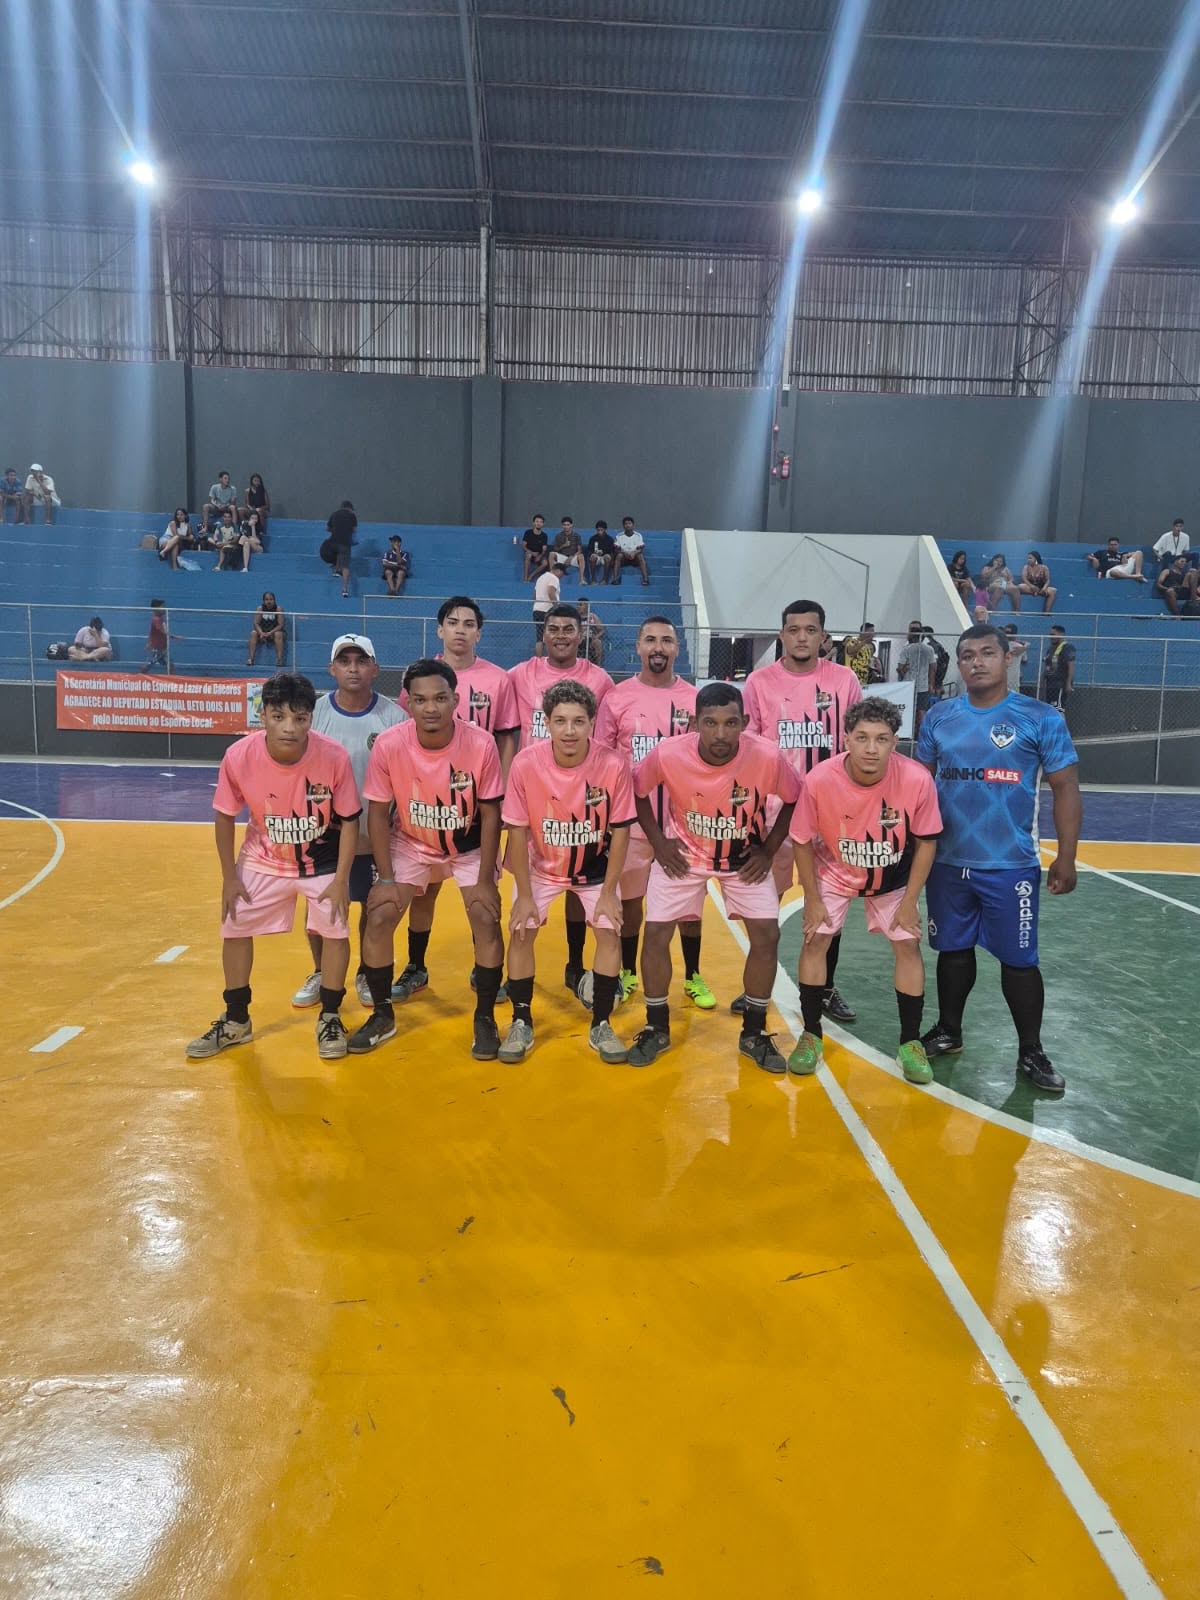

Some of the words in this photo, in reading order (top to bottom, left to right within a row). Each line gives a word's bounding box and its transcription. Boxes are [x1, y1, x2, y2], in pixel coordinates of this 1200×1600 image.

[106, 679, 142, 691] Municipal
[142, 680, 152, 691] de
[152, 681, 178, 693] Esporte
[183, 682, 202, 694] Lazer
[64, 695, 102, 707] AGRADECE
[102, 696, 112, 708] AO
[113, 697, 150, 709] DEPUTADO
[150, 698, 186, 711] ESTADUAL
[206, 700, 223, 712] DOIS
[224, 701, 230, 712] A
[230, 701, 242, 713] UM
[93, 713, 111, 725] pelo
[149, 716, 159, 726] ao
[160, 715, 190, 728] Esporte
[778, 721, 823, 736] CARLOS
[779, 734, 833, 749] AVALLONE
[987, 770, 1019, 781] SALES
[409, 802, 459, 819] CARLOS
[264, 815, 318, 831] CARLOS
[410, 814, 471, 831] AVALLONE
[542, 820, 592, 835] CARLOS
[687, 812, 736, 829] CARLOS
[543, 830, 603, 847] AVALLONE
[687, 822, 748, 840] AVALLONE
[838, 840, 892, 856] CARLOS
[1019, 898, 1033, 949] adidas
